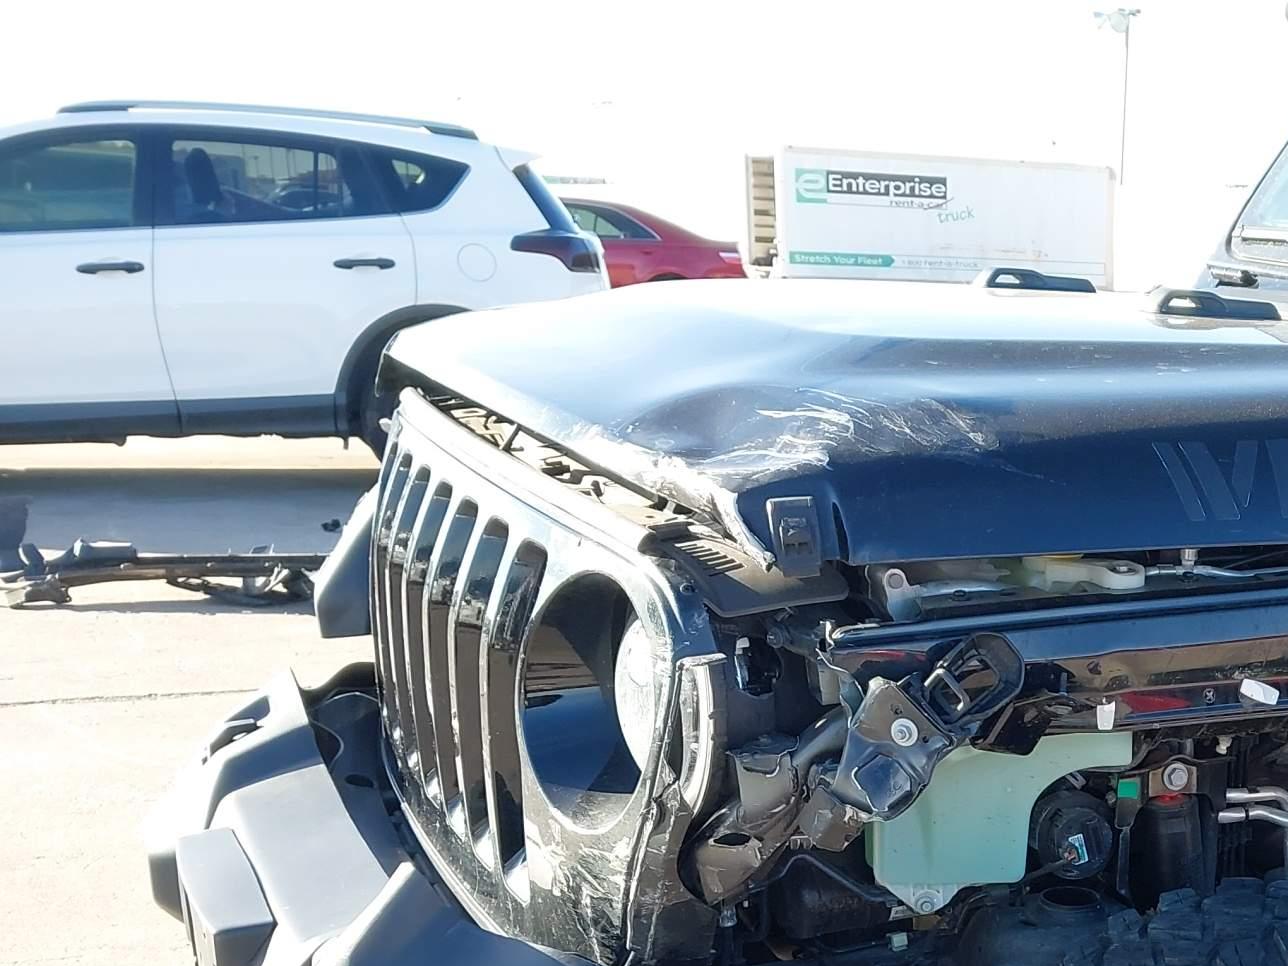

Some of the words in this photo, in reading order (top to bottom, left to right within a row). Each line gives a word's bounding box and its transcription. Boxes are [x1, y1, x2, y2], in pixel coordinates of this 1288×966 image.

[827, 173, 946, 197] Enterprise
[936, 206, 976, 224] truck
[794, 253, 831, 263] Stretch
[834, 255, 856, 264] Your
[857, 256, 883, 265] Fleet
